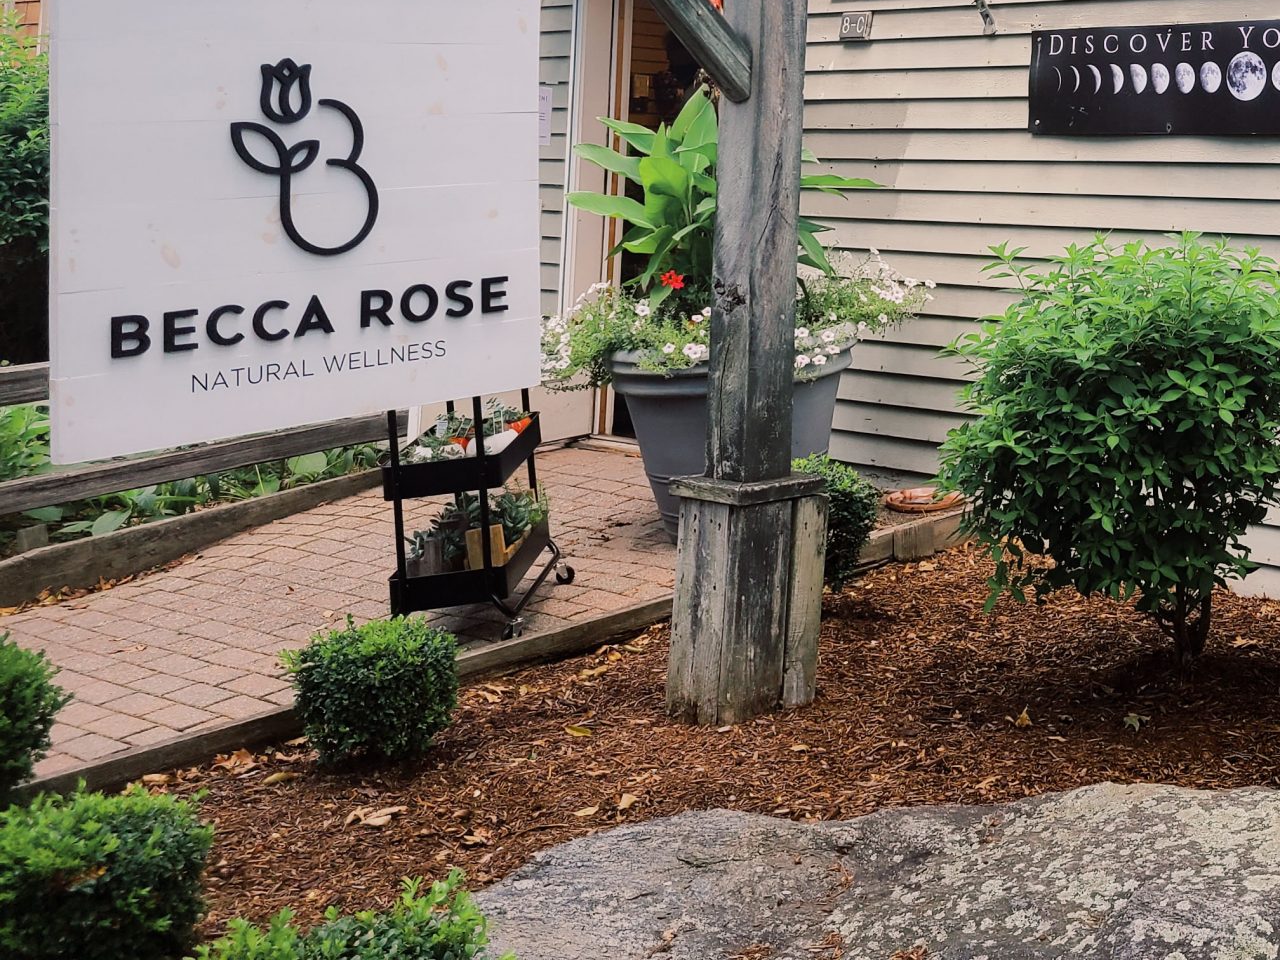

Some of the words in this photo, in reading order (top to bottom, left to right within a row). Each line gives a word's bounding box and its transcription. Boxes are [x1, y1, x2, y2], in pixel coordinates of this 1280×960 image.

[842, 16, 864, 33] 8-C
[1048, 30, 1215, 56] DISCOVER
[110, 294, 335, 359] BECCA
[359, 275, 510, 328] ROSE
[191, 359, 314, 393] NATURAL
[323, 339, 447, 374] WELLNESS
